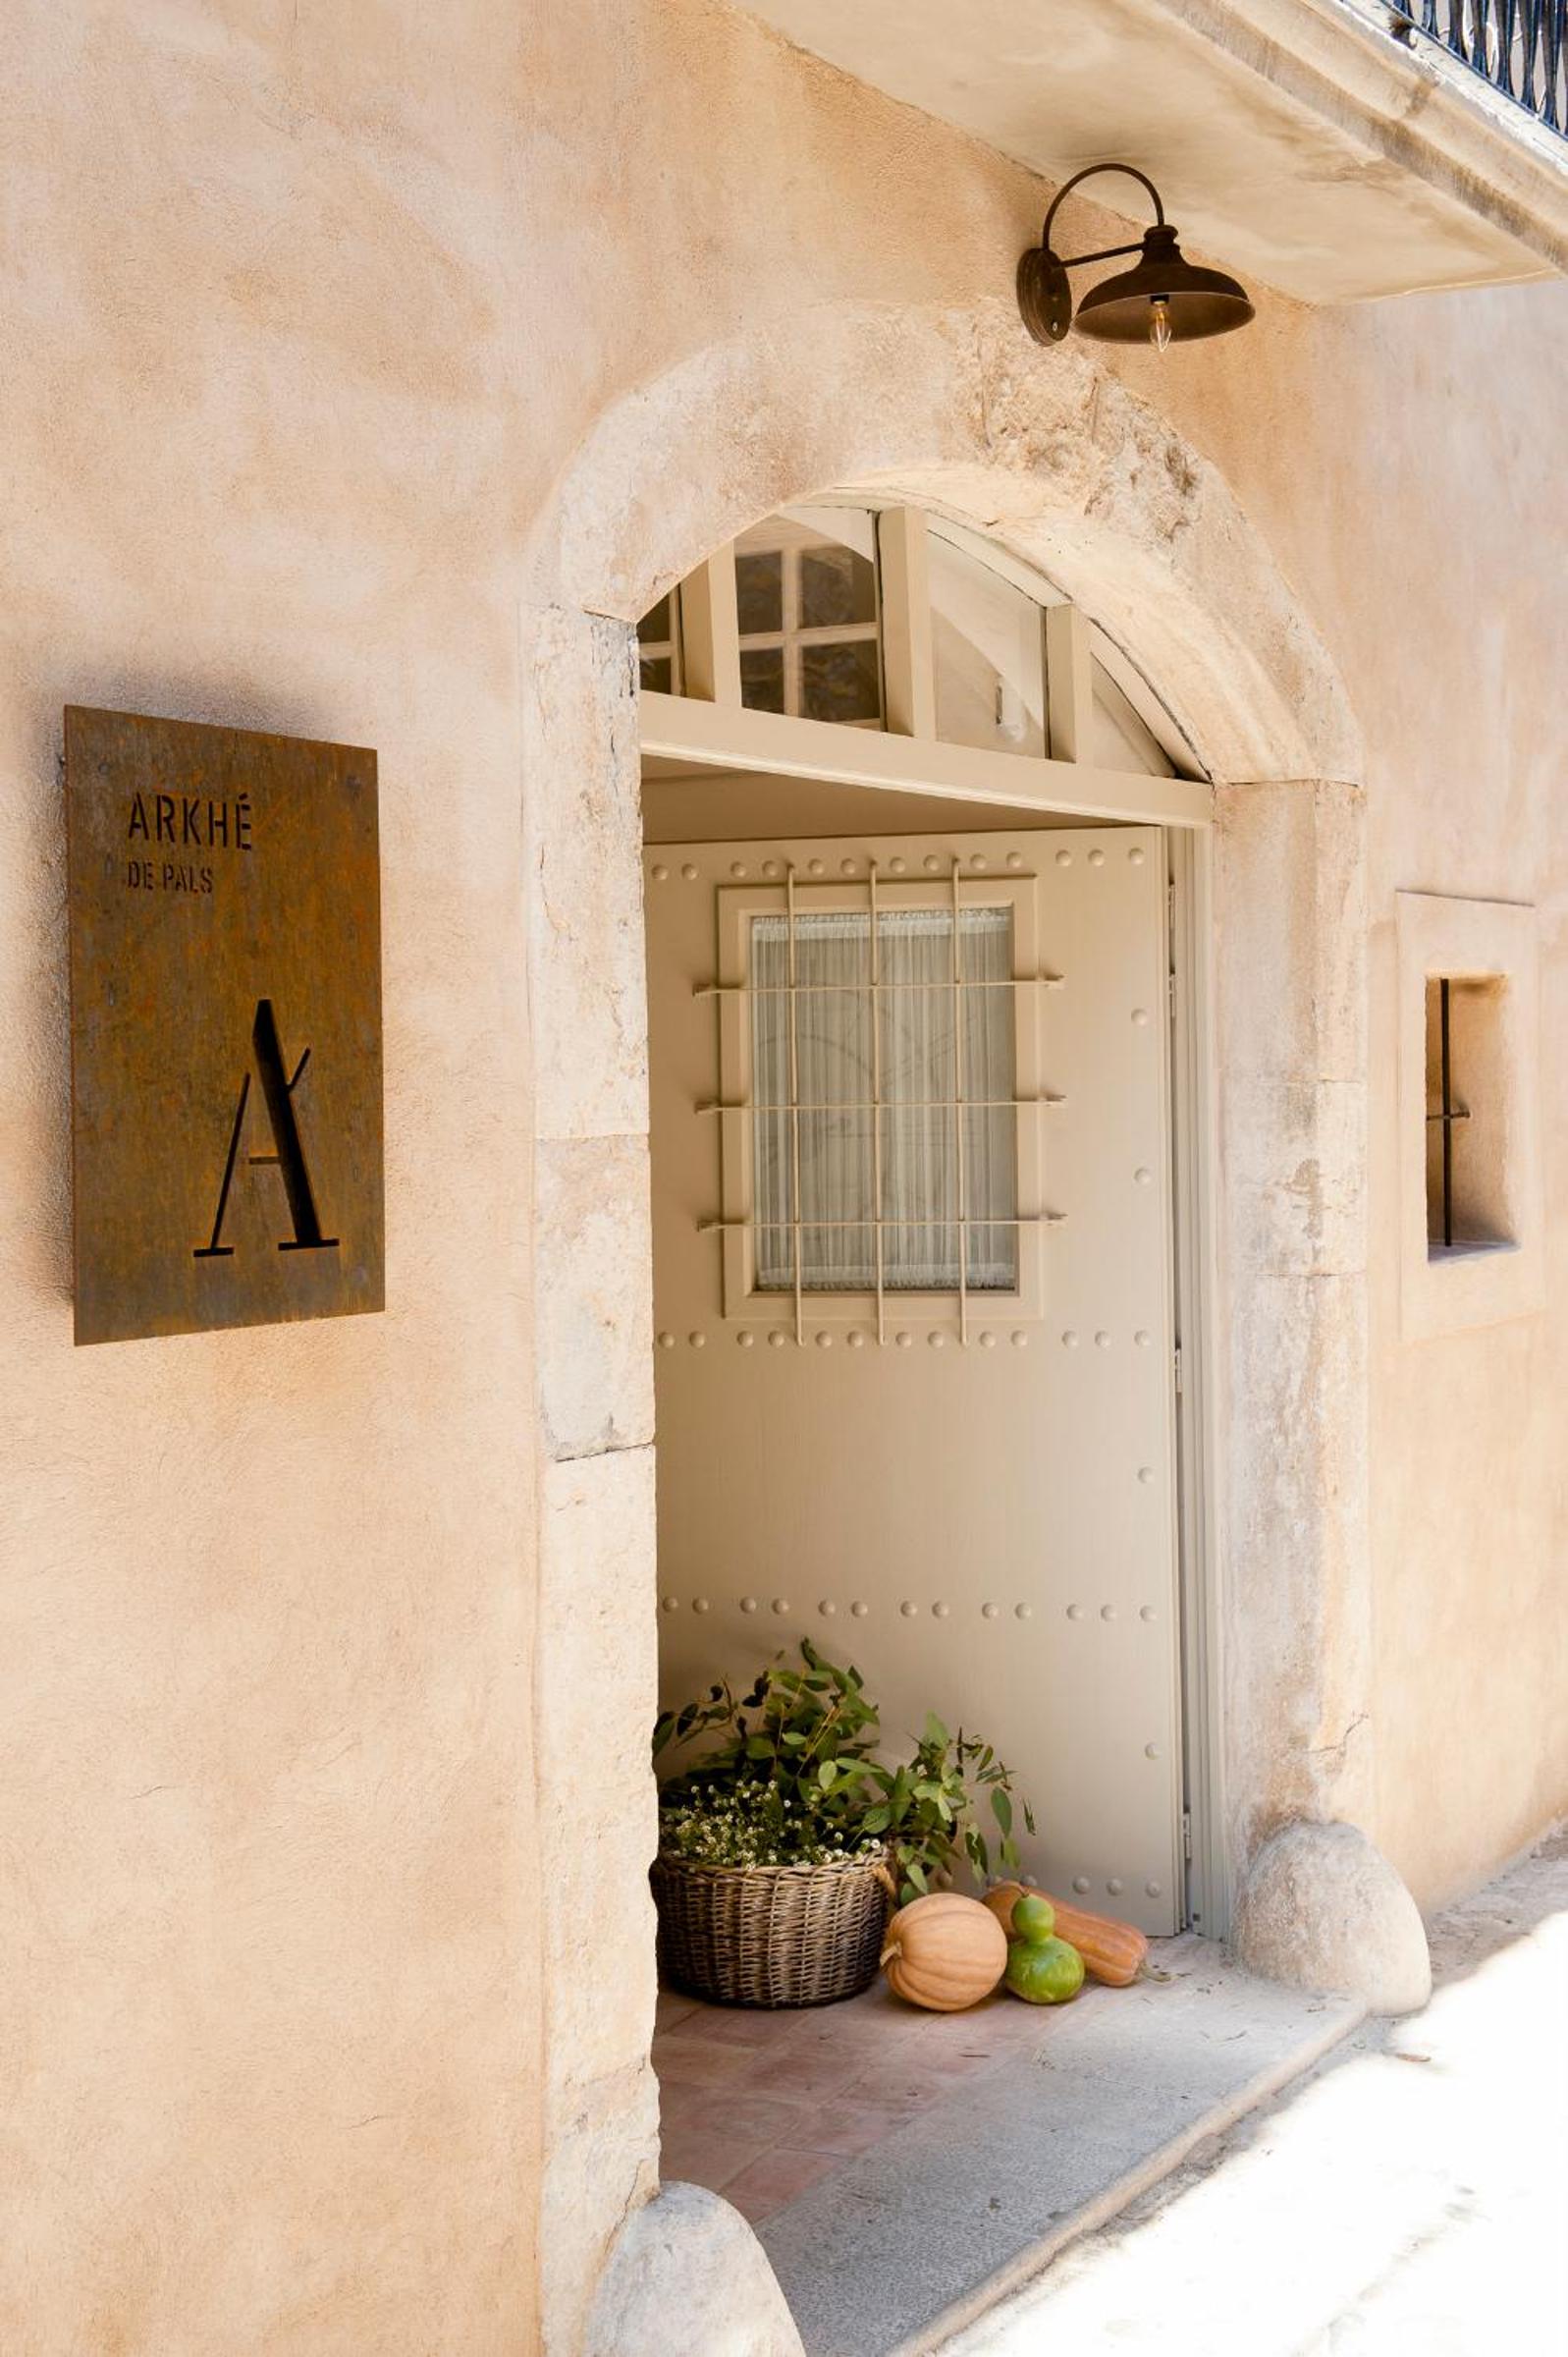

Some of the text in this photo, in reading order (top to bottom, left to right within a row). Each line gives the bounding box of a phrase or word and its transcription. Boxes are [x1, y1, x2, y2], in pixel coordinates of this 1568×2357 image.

[128, 792, 252, 851] ARKHÉ
[128, 860, 213, 894] DE PALS
[193, 999, 340, 1258] A
